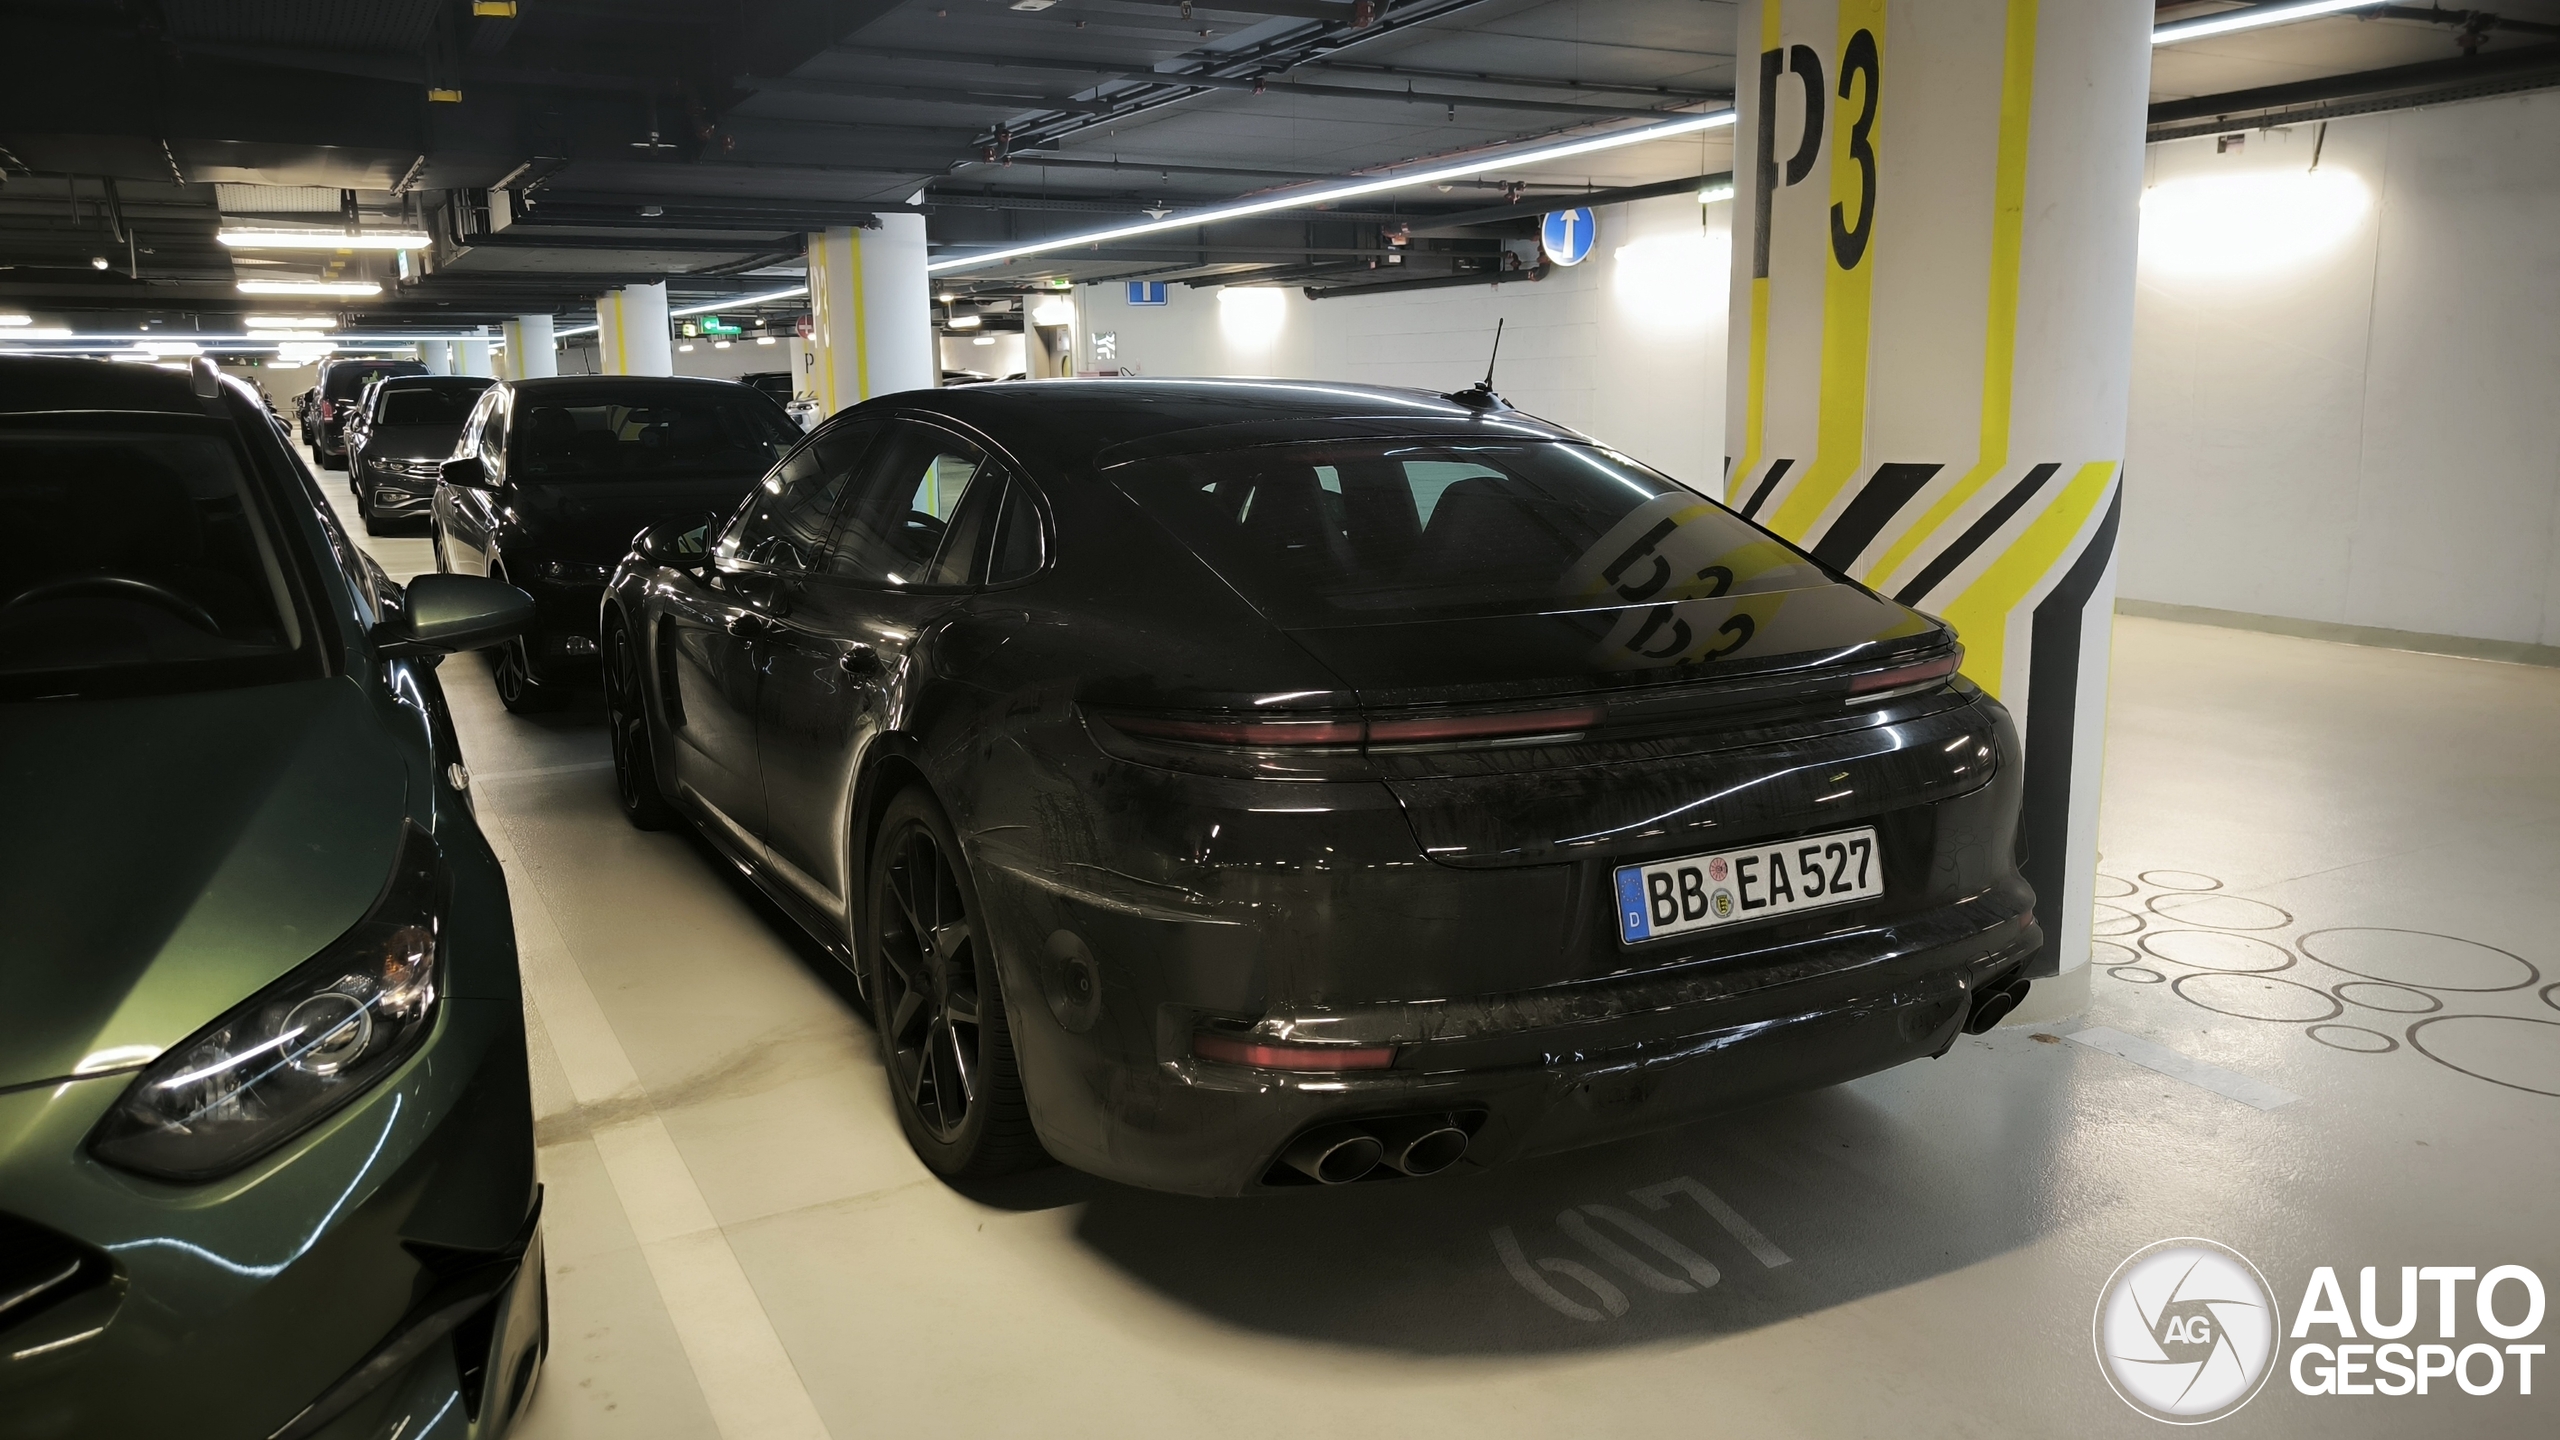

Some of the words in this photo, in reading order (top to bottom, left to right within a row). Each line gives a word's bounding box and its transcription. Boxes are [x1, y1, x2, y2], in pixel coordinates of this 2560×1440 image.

[1752, 28, 1880, 279] P3
[1628, 911, 1640, 928] D
[1647, 866, 1709, 926] BB
[1736, 852, 1795, 911] EA
[1799, 838, 1871, 898] 527
[1488, 1175, 1793, 1322] 607
